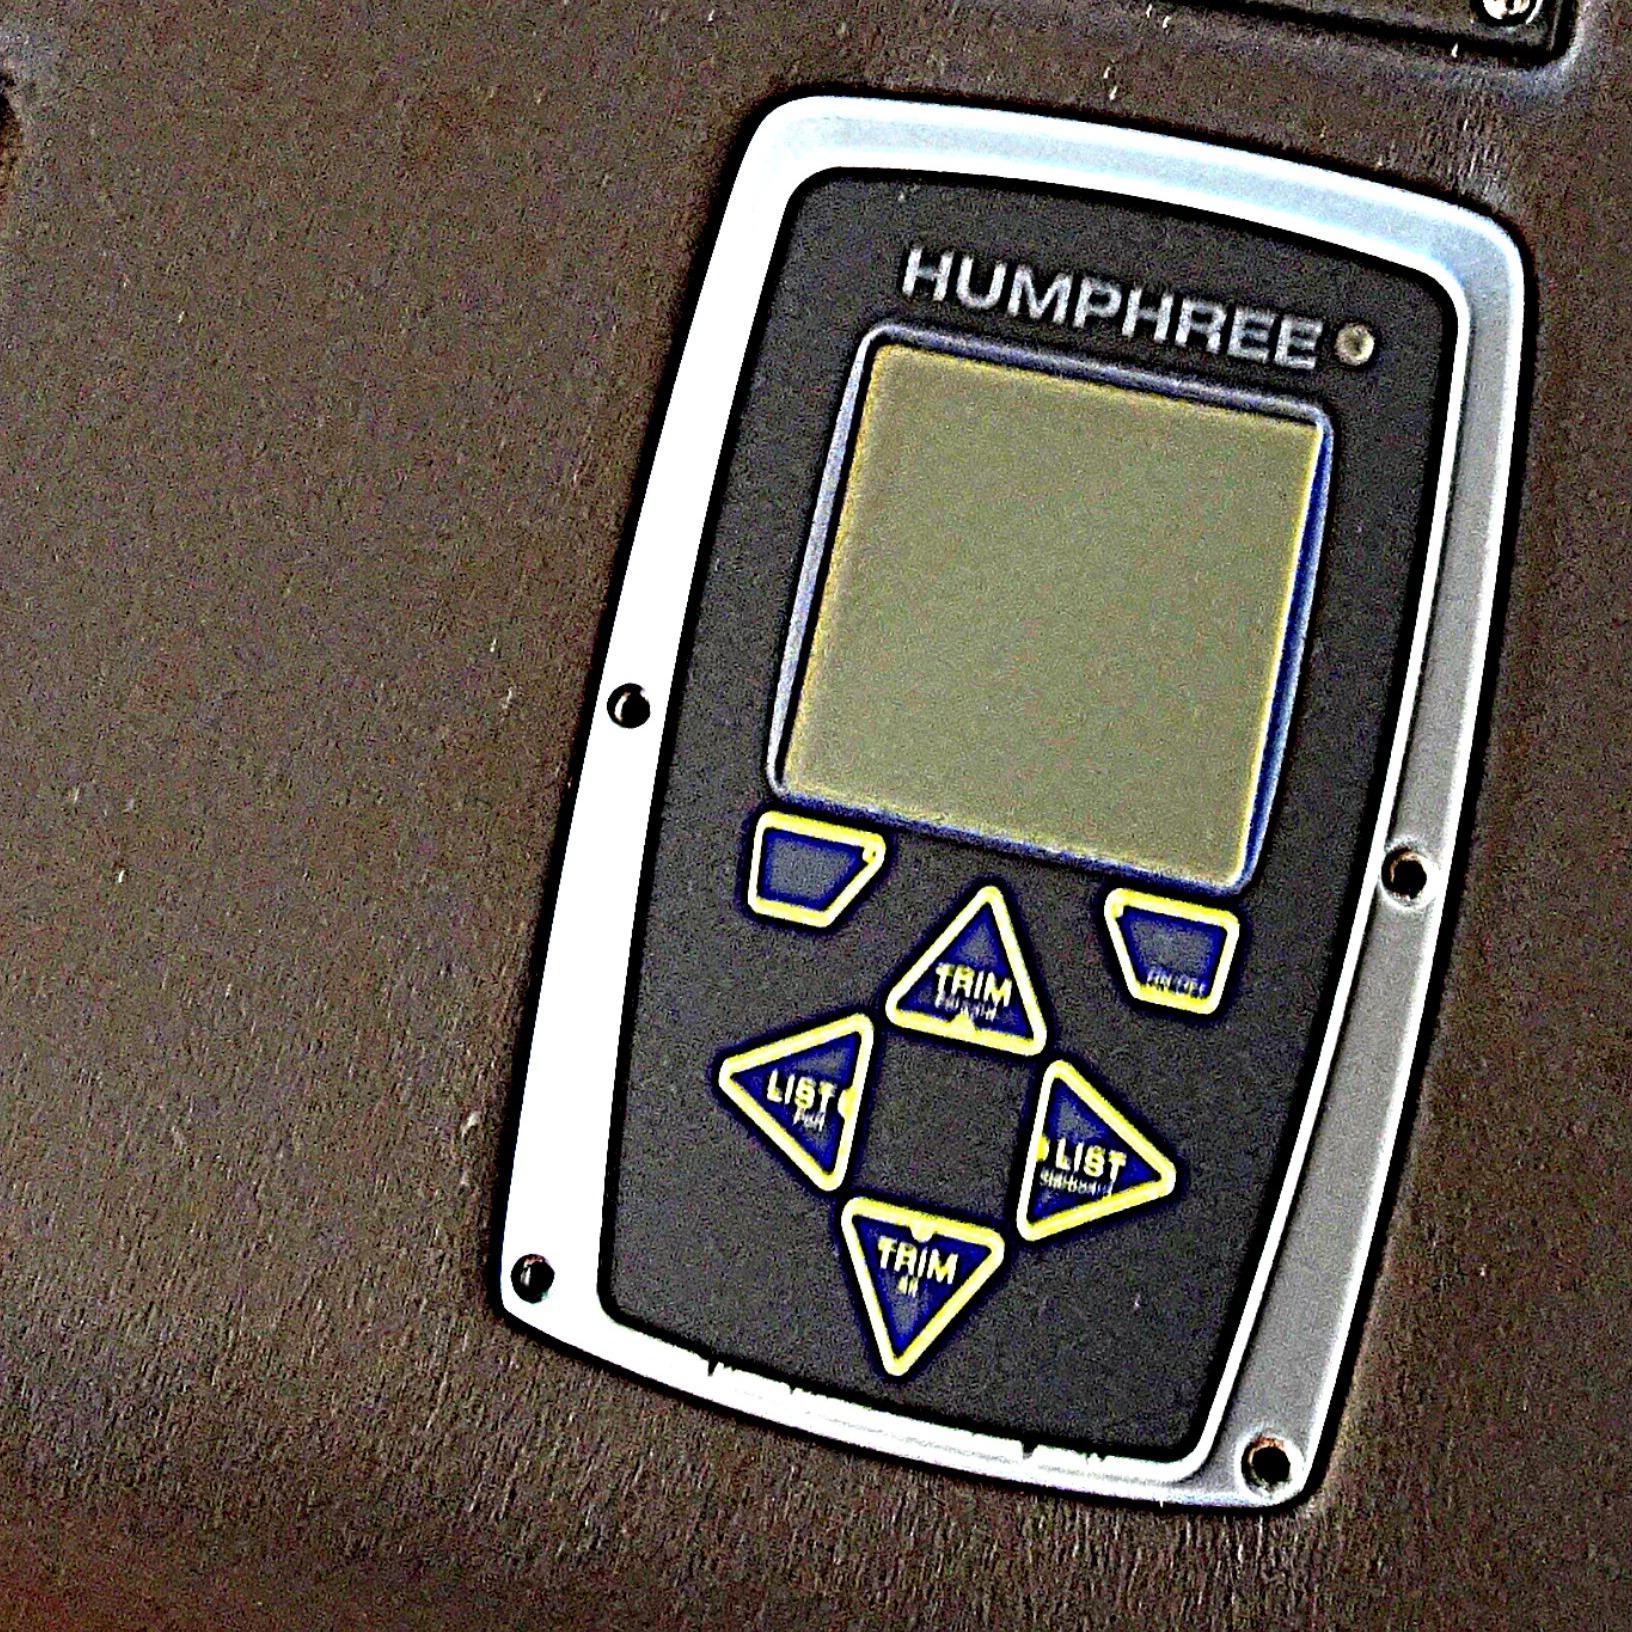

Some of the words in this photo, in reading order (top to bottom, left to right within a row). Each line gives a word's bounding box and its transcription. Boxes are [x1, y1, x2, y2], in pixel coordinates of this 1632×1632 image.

[901, 246, 1324, 371] HUMPHREE
[935, 963, 1012, 1008] TRIM
[766, 1068, 837, 1114] LIST
[1055, 1137, 1127, 1183] LIST
[877, 1234, 959, 1285] TRIM
